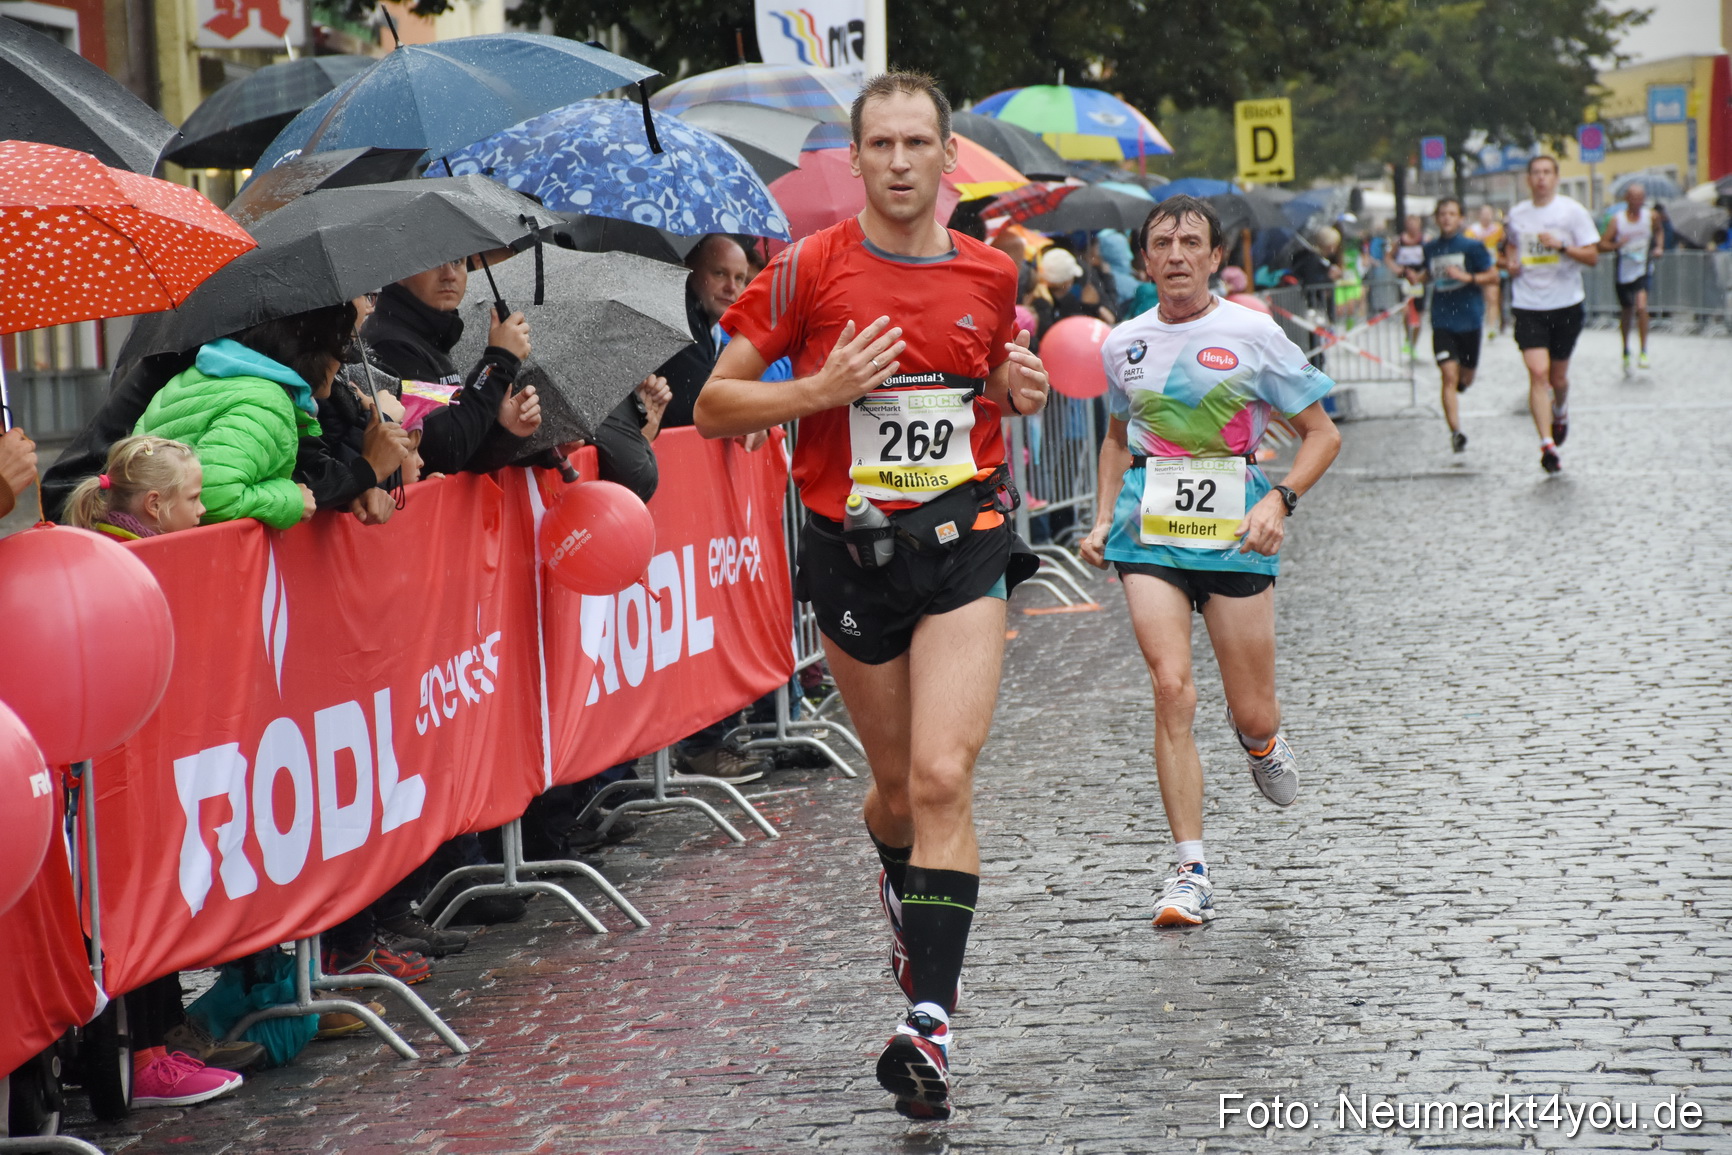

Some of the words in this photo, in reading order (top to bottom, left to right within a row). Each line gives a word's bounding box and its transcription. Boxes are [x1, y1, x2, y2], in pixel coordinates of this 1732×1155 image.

[1252, 125, 1279, 163] D
[1202, 351, 1235, 366] Hervis
[1124, 367, 1145, 377] PARTL
[908, 394, 962, 409] BOCK
[879, 419, 954, 462] 269
[1190, 459, 1236, 471] BOCK
[879, 471, 949, 487] Matthias
[1175, 479, 1217, 513] 52
[1169, 520, 1217, 536] Herbert
[904, 893, 952, 902] FALKE
